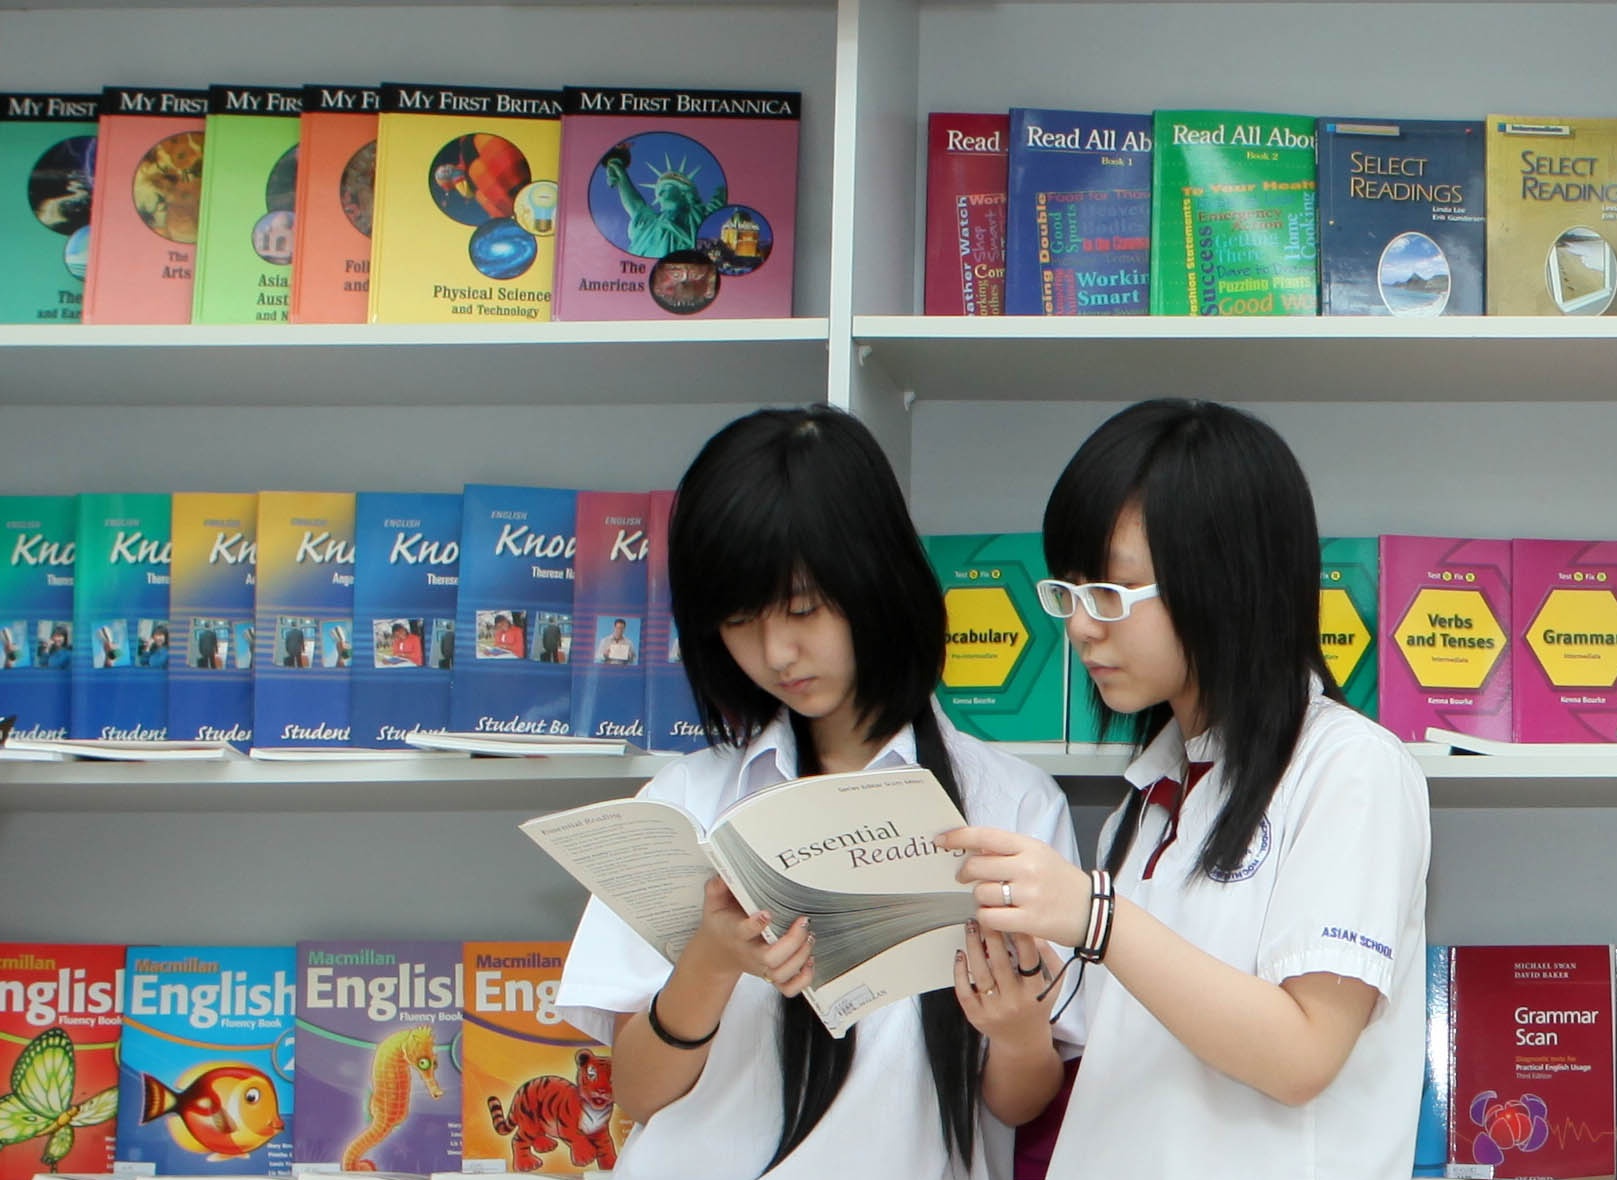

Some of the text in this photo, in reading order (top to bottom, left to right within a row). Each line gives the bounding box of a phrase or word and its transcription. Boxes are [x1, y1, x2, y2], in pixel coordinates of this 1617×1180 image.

[580, 92, 792, 115] MY FIRST BRITANNICA
[1027, 126, 1115, 150] Read All
[1172, 125, 1261, 146] Read All
[1350, 151, 1428, 177] SELECT
[1521, 150, 1598, 177] SELECT
[1350, 176, 1463, 204] READINGS
[162, 266, 192, 280] Arts
[619, 261, 646, 274] The
[432, 285, 493, 302] Physical
[579, 278, 645, 292] Americas
[1077, 290, 1141, 307] Smart
[452, 304, 540, 319] and Technology
[1428, 613, 1473, 631] Verbs
[1407, 633, 1495, 649] and Tenses
[281, 722, 352, 741] Student
[474, 716, 546, 734] Student
[776, 820, 902, 870] Essential
[1321, 926, 1394, 961] ASIAN SCHOOL
[136, 957, 219, 973] Macmillan
[307, 949, 395, 966] Macmillan
[1515, 962, 1577, 970] MICHAEL SWAN
[1515, 971, 1569, 979] DAVID BAKER
[131, 971, 295, 1029] English
[221, 1019, 282, 1031] Fluency Book
[1515, 1006, 1599, 1027] Grammar
[1515, 1029, 1558, 1047] Scan
[1515, 1064, 1592, 1073] Practical English Usage
